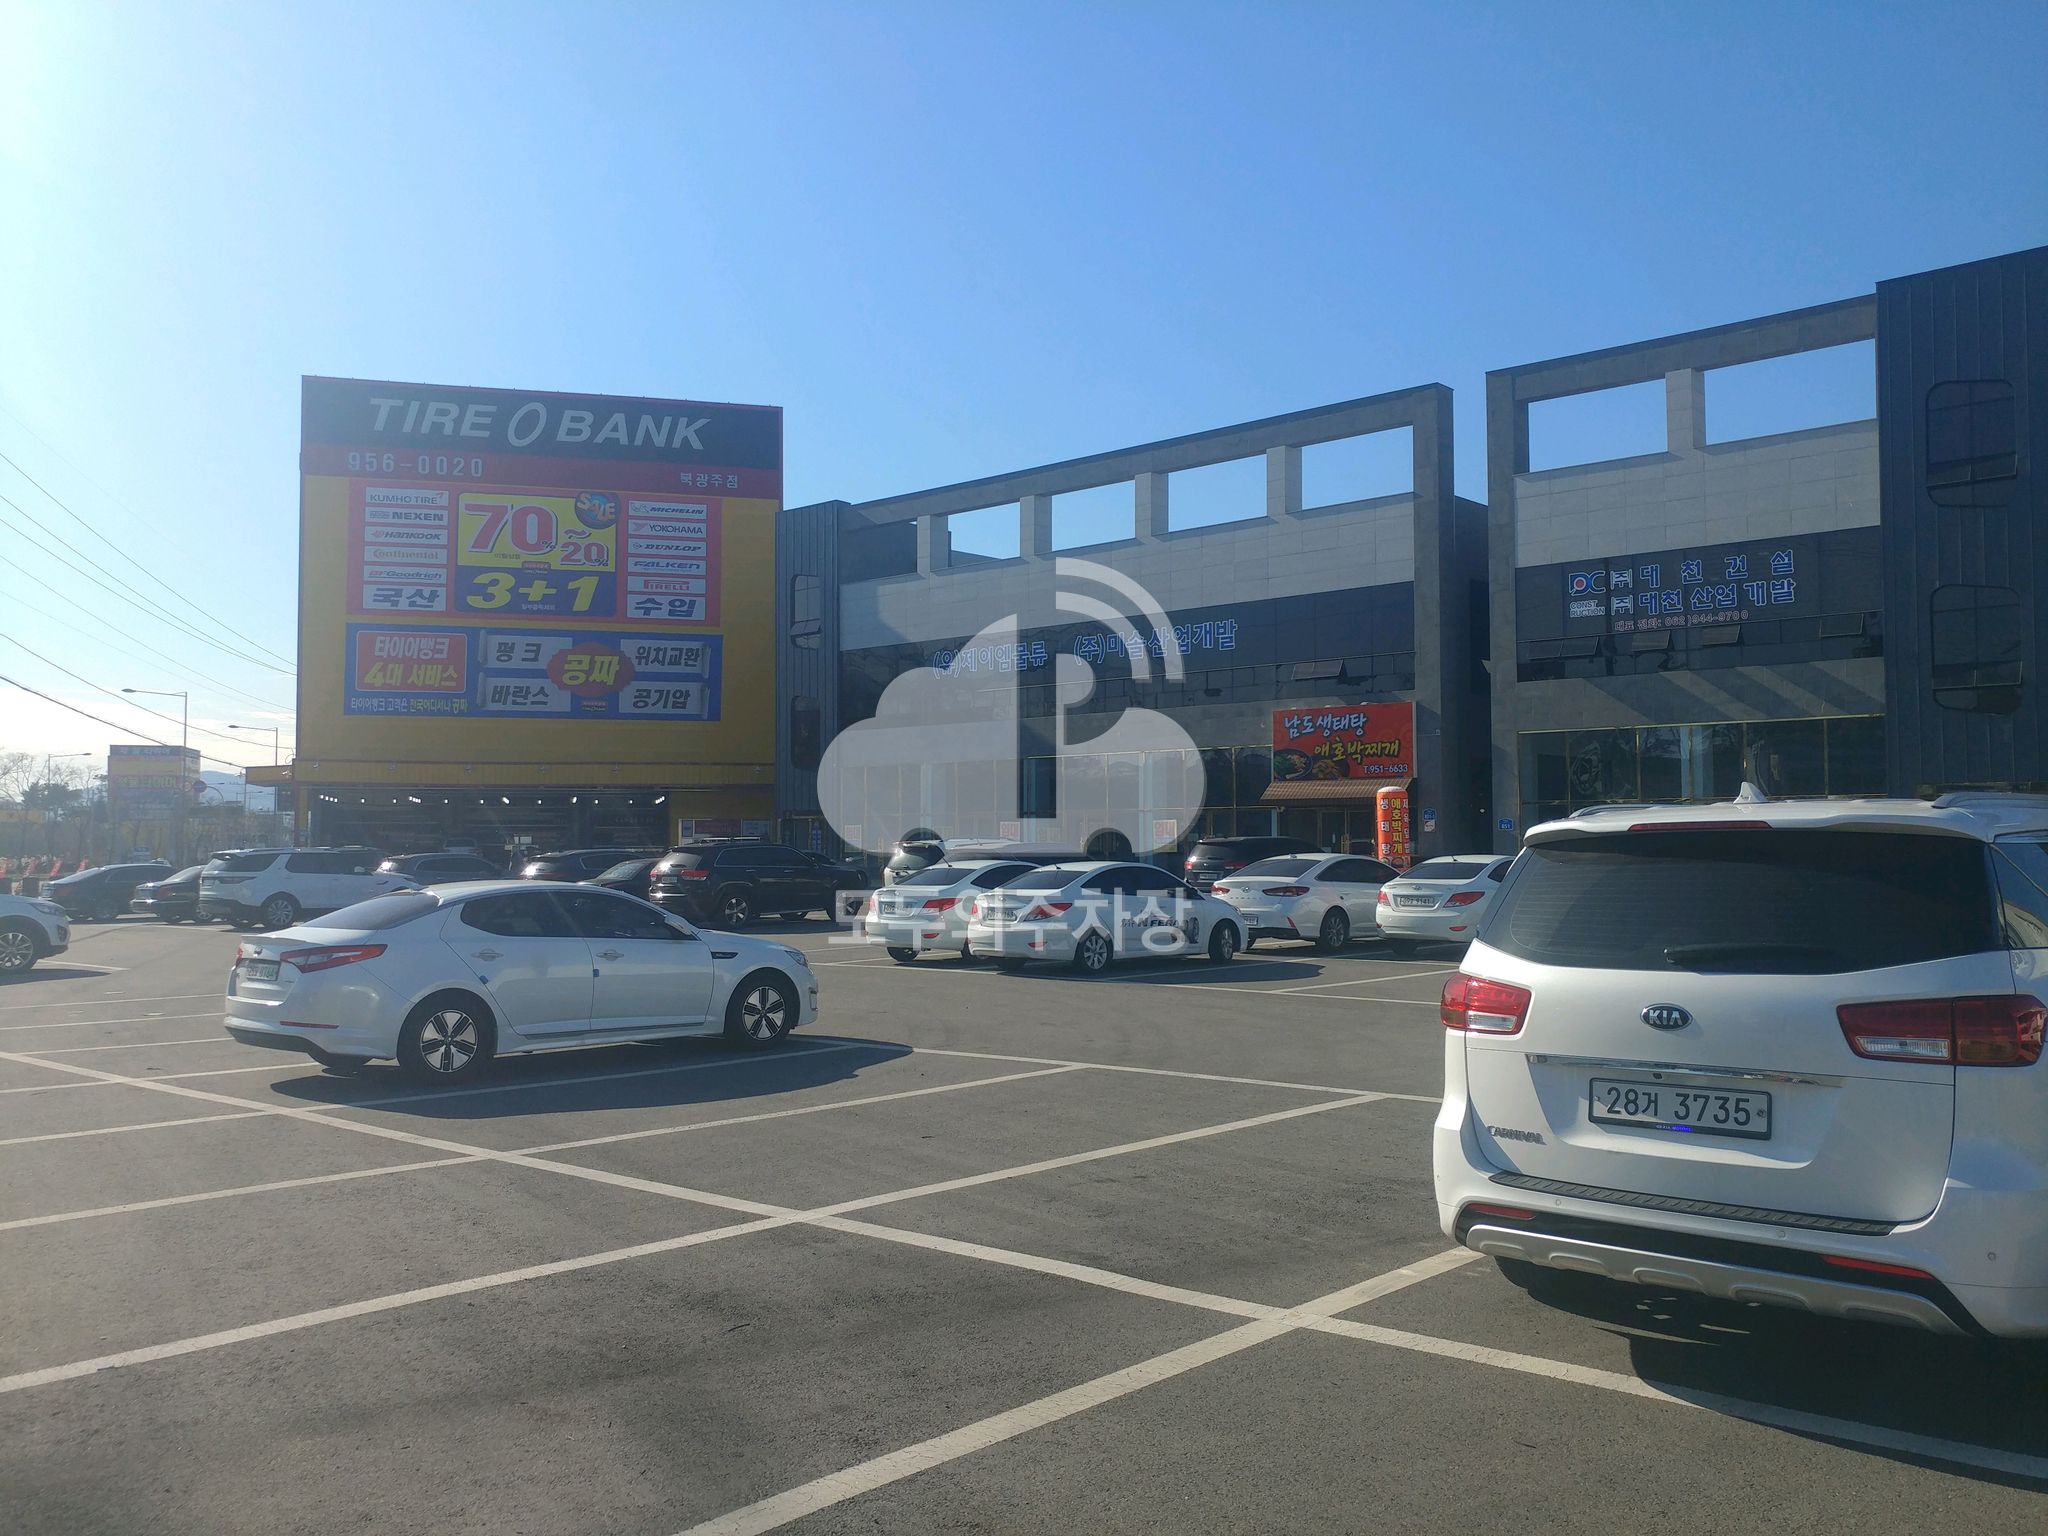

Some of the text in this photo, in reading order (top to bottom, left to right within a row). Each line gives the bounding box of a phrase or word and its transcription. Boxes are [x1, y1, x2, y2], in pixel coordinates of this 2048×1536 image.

[370, 398, 498, 438] TIRE
[556, 410, 711, 450] BANK
[348, 452, 483, 477] 956-0020
[680, 472, 738, 489] 북광주점
[370, 494, 438, 505] KUMHO TIRE
[391, 511, 444, 522] NEXEN
[649, 506, 704, 515] MICHELIN
[649, 524, 703, 534] YOKOHAMA
[373, 548, 440, 560] Continental
[644, 543, 702, 552] DUNLOP
[643, 579, 690, 591] PIRELLI
[372, 587, 440, 608] 국산
[634, 597, 697, 618] 수입
[1570, 599, 1598, 609] CONST
[374, 636, 450, 660] 타이어뱅크
[634, 645, 701, 668] 위치교환
[364, 661, 459, 688] 4대 서비스
[562, 653, 620, 686] 공짜
[351, 697, 385, 712] 타이어뱅크
[490, 684, 550, 706] 바란스
[632, 687, 691, 710] 공기압
[1314, 736, 1400, 764] 애호박찌개
[1649, 1009, 1684, 1026] KIA
[1606, 1086, 1751, 1127] 28거 3735
